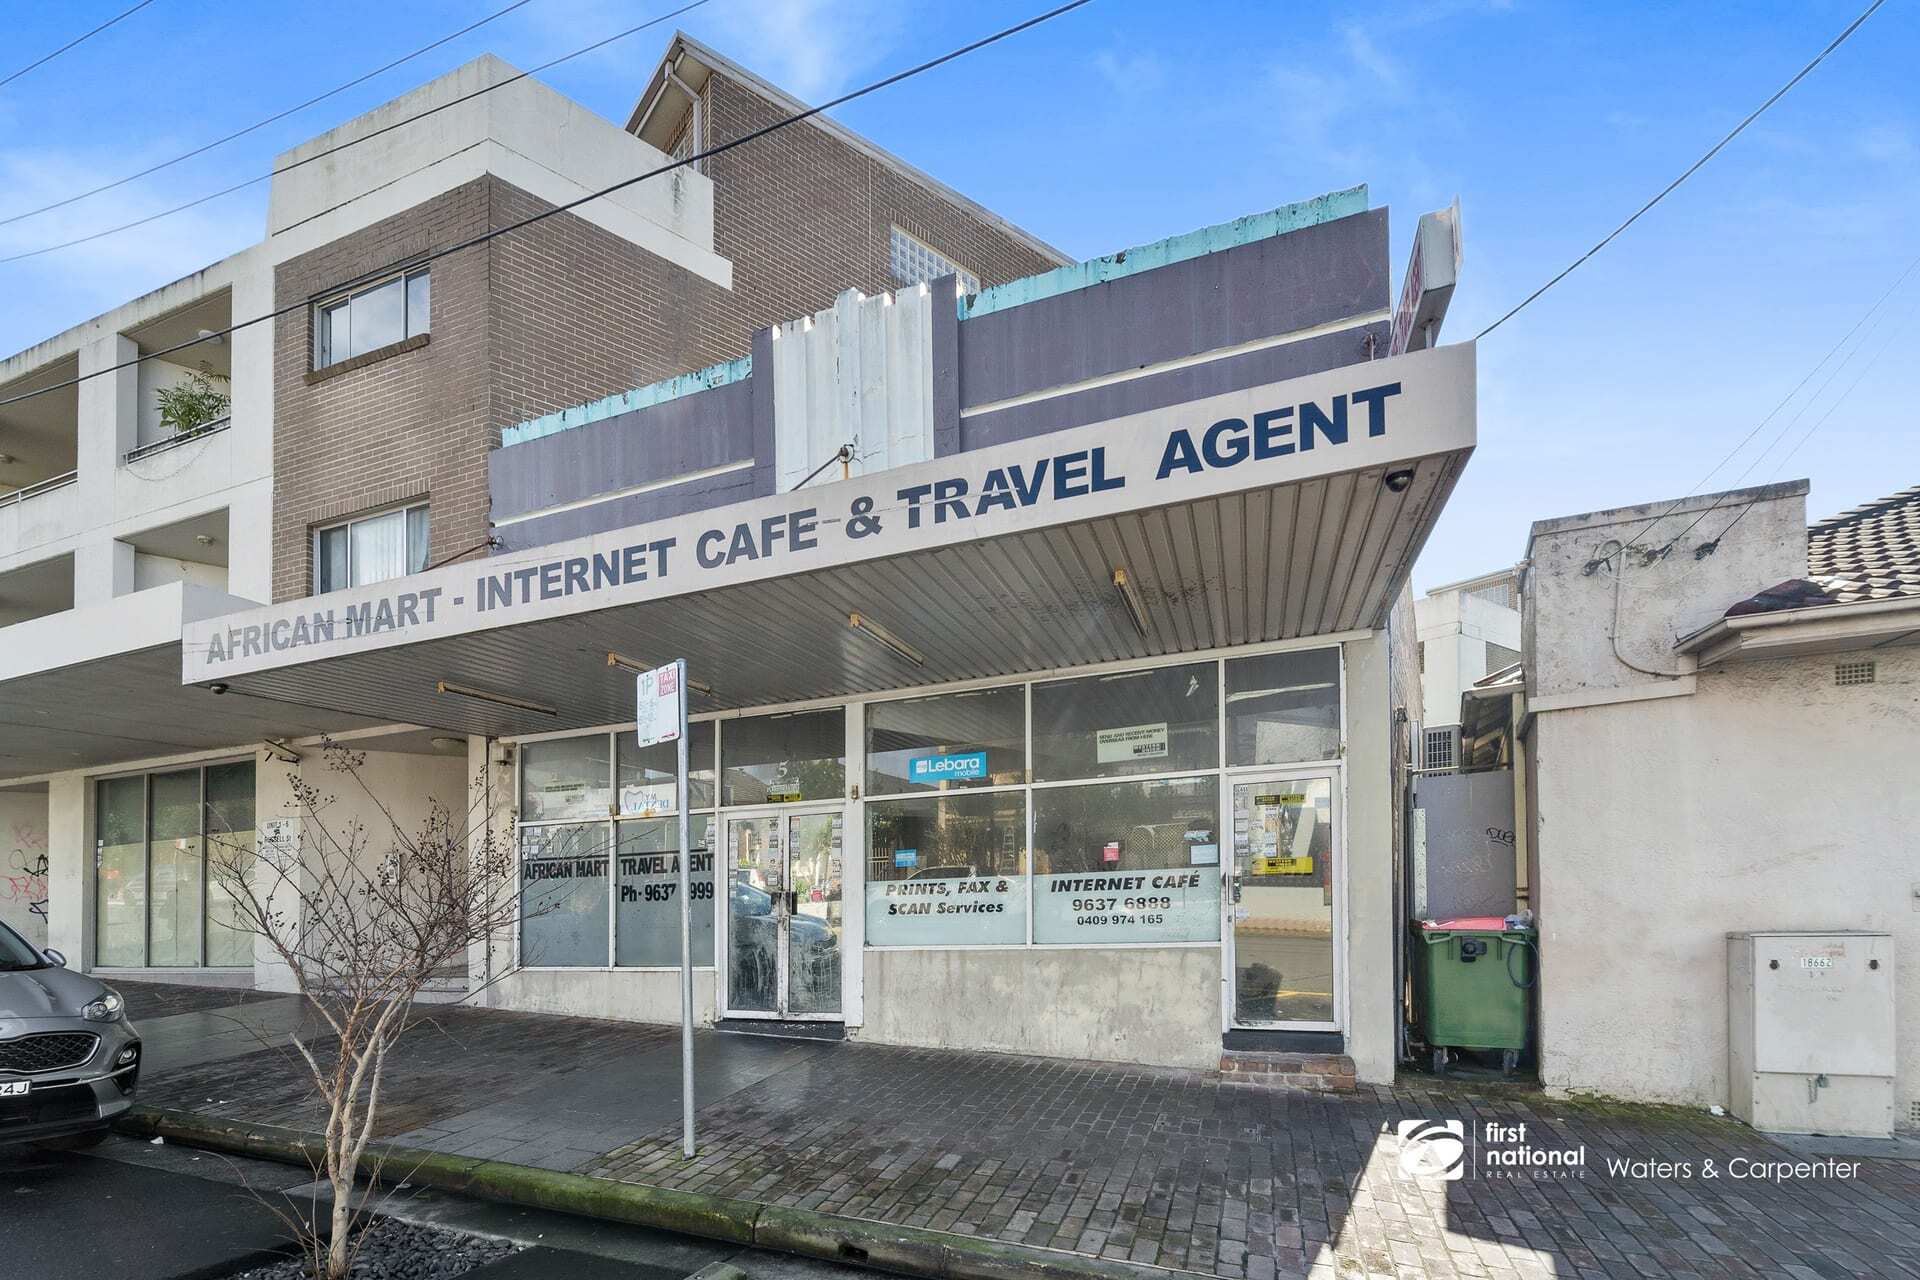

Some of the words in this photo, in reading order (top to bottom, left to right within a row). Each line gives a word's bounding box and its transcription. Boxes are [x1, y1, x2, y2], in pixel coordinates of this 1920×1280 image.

[205, 608, 335, 664] AFRICAN
[345, 586, 442, 638] MART
[476, 537, 677, 612] INTERNET
[695, 507, 818, 570] CAFE
[845, 496, 883, 539] &
[896, 446, 1126, 530] TRAVEL
[1155, 381, 1402, 481] AGENT
[928, 757, 980, 773] Lebara
[954, 769, 980, 777] mobile
[524, 861, 573, 880] AFRICAN
[576, 860, 609, 877] MART
[621, 856, 668, 875] TRAVEL
[671, 853, 714, 873] AENT
[645, 883, 676, 901] 9637
[886, 882, 951, 896] PRINTS,
[957, 882, 991, 894] FAX
[995, 880, 1009, 893] &
[1050, 876, 1145, 893] INTERNET
[888, 903, 932, 915] SCAN
[936, 900, 1004, 915] Services
[1072, 899, 1117, 911] 9637
[1077, 916, 1108, 925] 0409
[1112, 915, 1135, 925] 974
[1140, 915, 1163, 924] 165
[1803, 958, 1831, 967] 18662
[0, 1082, 27, 1096] 4J
